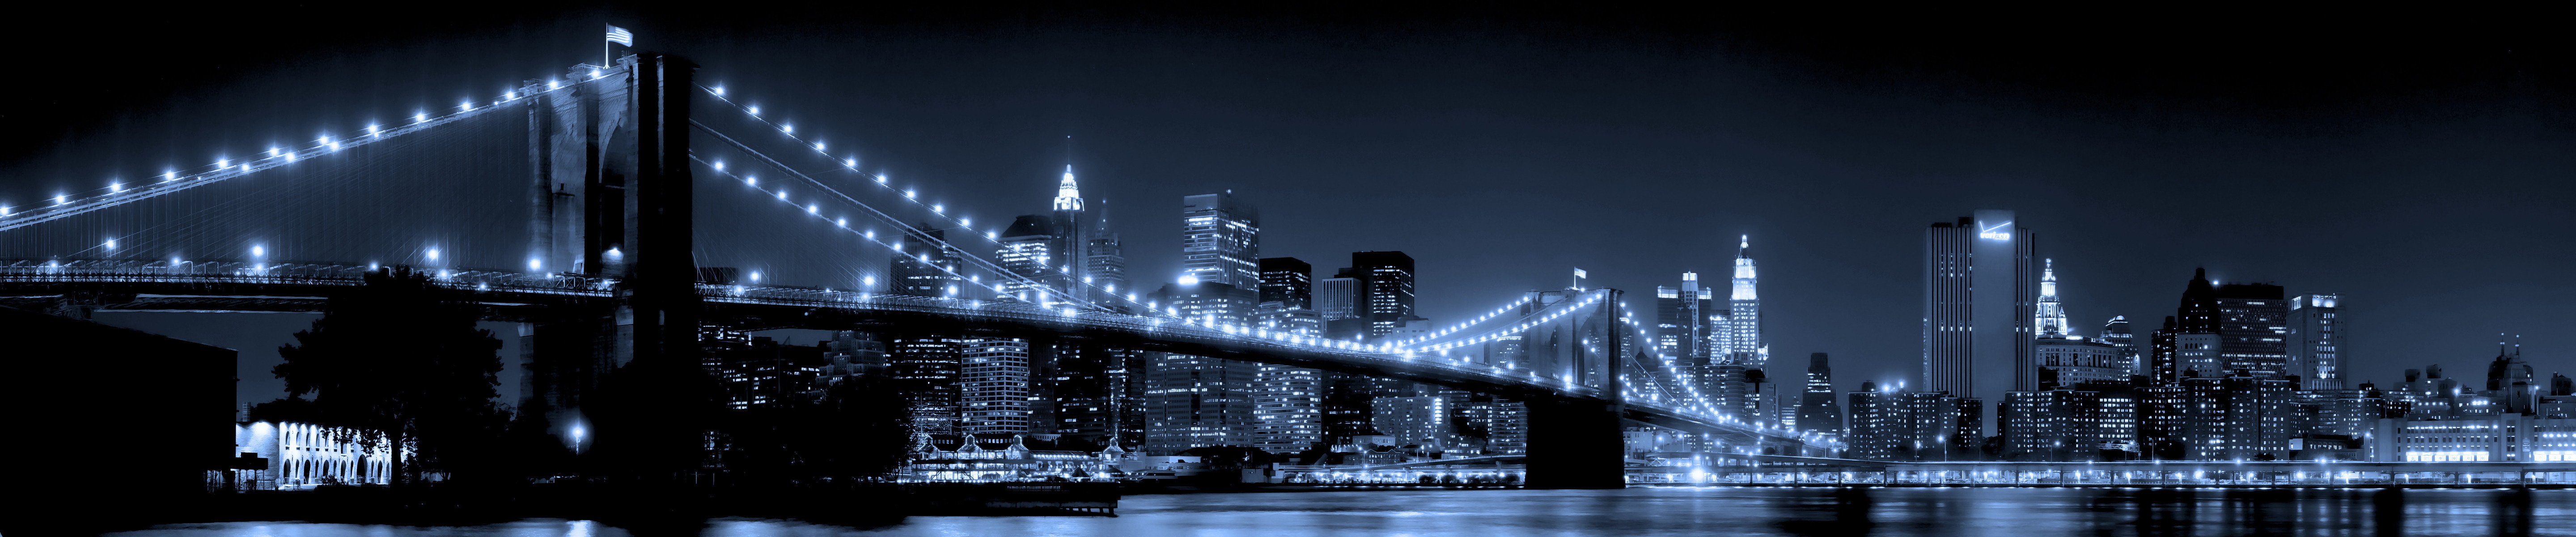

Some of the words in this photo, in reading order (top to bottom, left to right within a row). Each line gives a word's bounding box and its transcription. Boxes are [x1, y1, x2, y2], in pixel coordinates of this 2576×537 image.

[1980, 231, 2010, 240] verizon
[1036, 461, 1076, 471] PIER
[1080, 461, 1094, 471] 17
